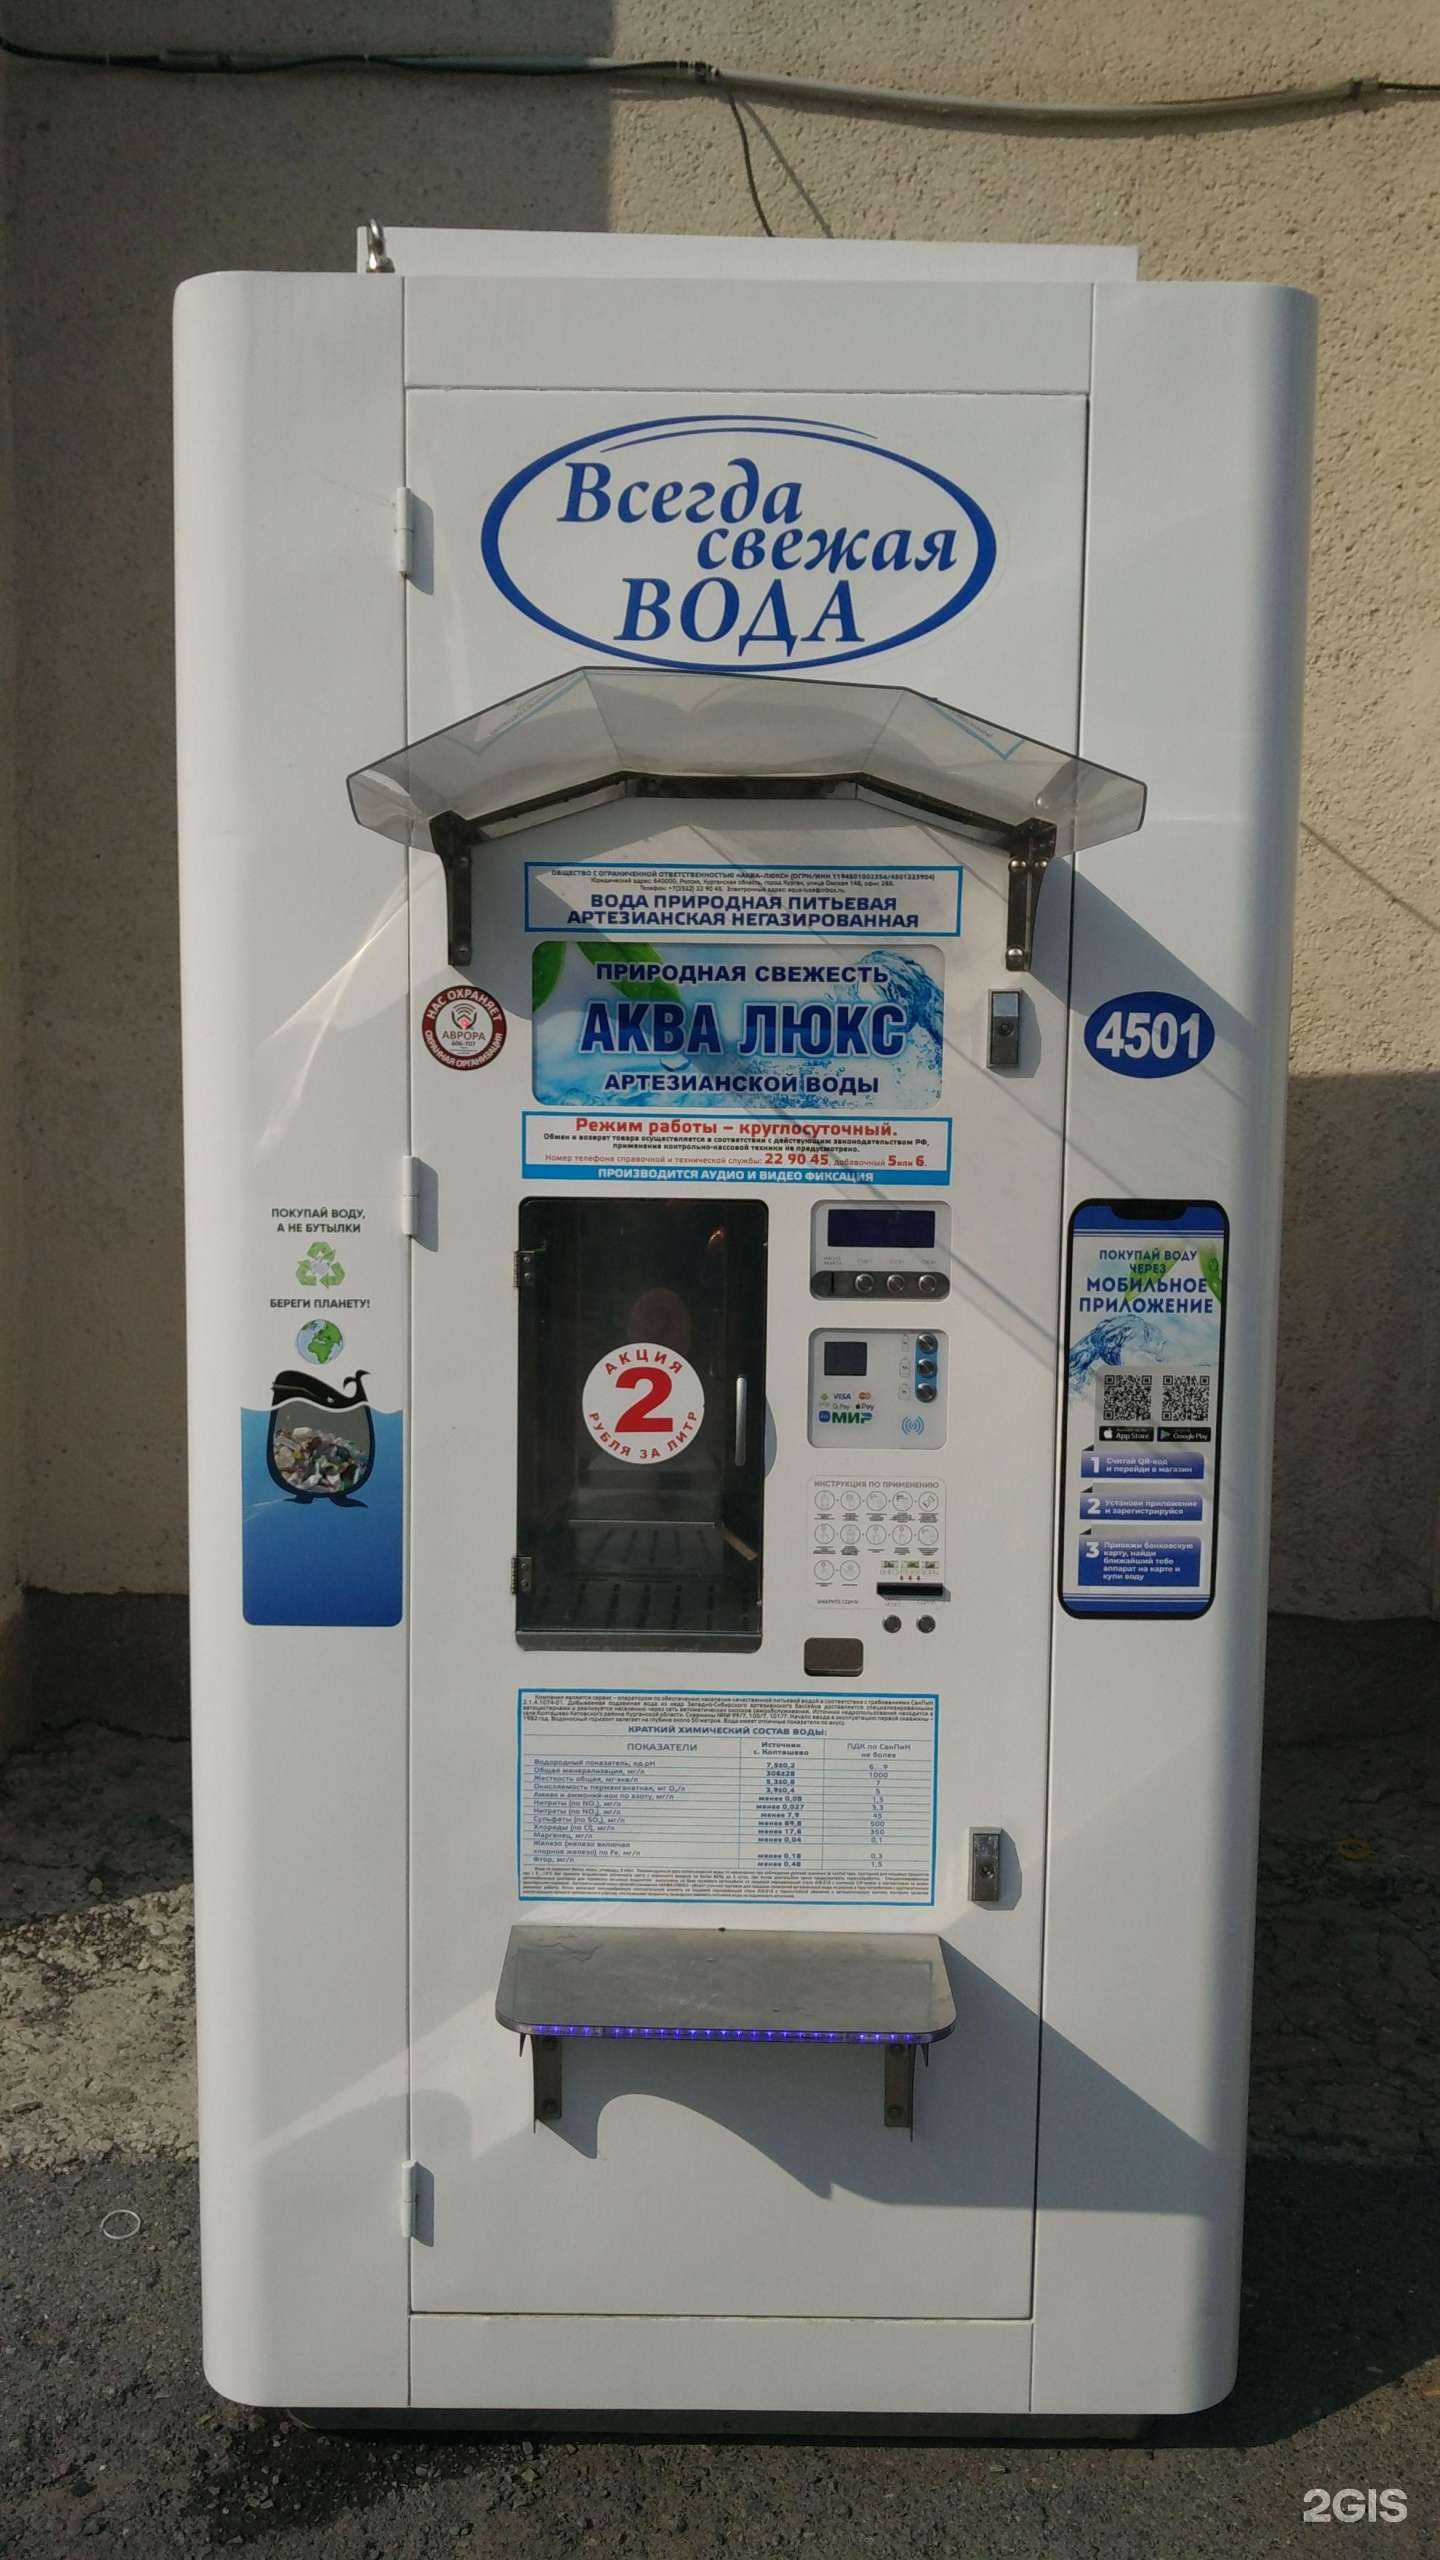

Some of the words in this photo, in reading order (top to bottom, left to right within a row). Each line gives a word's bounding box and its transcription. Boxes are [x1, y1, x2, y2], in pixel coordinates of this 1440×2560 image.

[557, 457, 803, 524] Всегда
[697, 526, 958, 573] свежая
[614, 577, 866, 657] ВОДА
[591, 894, 649, 910] ВОДА
[654, 894, 782, 911] ПРИРОДНАЯ
[788, 897, 897, 910] ПИТЬЕВАЯ
[567, 910, 725, 926] АРТЕЗИАНСКАЯ
[732, 912, 919, 928] НЕГАЗИРОВАННАЯ
[596, 962, 746, 984] ПРИРОДНАЯ
[754, 965, 889, 984] СВЕЖЕСТЬ
[427, 997, 447, 1020] НАС
[447, 988, 503, 1022] ОХРАНЯЕТ
[441, 1030, 487, 1042] АВРОРА
[579, 1000, 725, 1055] АКВА
[738, 1002, 908, 1057] ЛЮКС
[1096, 1011, 1200, 1059] 4501
[604, 1072, 798, 1094] АРТЕЗИАНСКОЙ
[806, 1076, 879, 1095] ВОДЫ
[576, 1118, 643, 1132] Режим
[649, 1120, 717, 1136] работы
[739, 1122, 898, 1138] круглосуточный.
[579, 1134, 610, 1142] возврат
[642, 1135, 705, 1143] осуществляется
[714, 1136, 766, 1144] соответствии
[833, 1138, 913, 1146] законодательством
[612, 1142, 662, 1150] применения
[664, 1144, 750, 1152] контрольно-кассовой
[616, 1156, 666, 1164] справочной
[764, 1152, 783, 1165] 22
[788, 1153, 806, 1166] 90
[598, 1168, 698, 1180] ПРОИЗВОДИТСЯ
[700, 1170, 747, 1181] АУДИО
[748, 1171, 758, 1180] И
[760, 1171, 803, 1182] ВИДЕО
[805, 1172, 874, 1182] ФИКСАЦИЯ
[272, 1207, 328, 1220] ПОКУПАЙ
[331, 1208, 366, 1220] ВОДУ,
[277, 1223, 286, 1232] А
[287, 1223, 303, 1232] НЕ
[305, 1223, 361, 1233] БУТЫЛКИ
[1099, 1249, 1160, 1260] ПОКУПАЙ
[1164, 1250, 1198, 1262] ВОДУ
[1130, 1264, 1167, 1274] ЧЕРЕЗ
[1087, 1277, 1207, 1294] МОБИЛЬНОЕ
[270, 1298, 311, 1308] БЕРЕГИ
[314, 1298, 370, 1309] ПЛАНЕТУ!
[1080, 1297, 1214, 1314] ПРИЛОЖЕНИЕ
[604, 1349, 682, 1376] АКЦИЯ
[614, 1367, 673, 1434] 2
[834, 1392, 852, 1400] VISA
[832, 1412, 872, 1424] МИР
[588, 1411, 631, 1458] РУБЛЯ
[640, 1448, 662, 1460] ЗА
[668, 1410, 698, 1458] ЛИТР
[1116, 1432, 1131, 1440] App
[1091, 1456, 1099, 1473] 1
[1106, 1457, 1136, 1465] Считай
[814, 1480, 866, 1488] ИНСТРУКЦИЯ
[882, 1481, 939, 1490] ПРИМЕНЕНИЮ
[1088, 1498, 1101, 1514] 2
[1086, 1542, 1100, 1558] 3
[628, 1725, 676, 1734] КРАТКИЙ
[678, 1726, 750, 1735] ХИМИЧЕСКИЙ
[792, 1728, 828, 1736] ВОДЫ:
[627, 1743, 698, 1751] ПОКАЗАТЕЛИ
